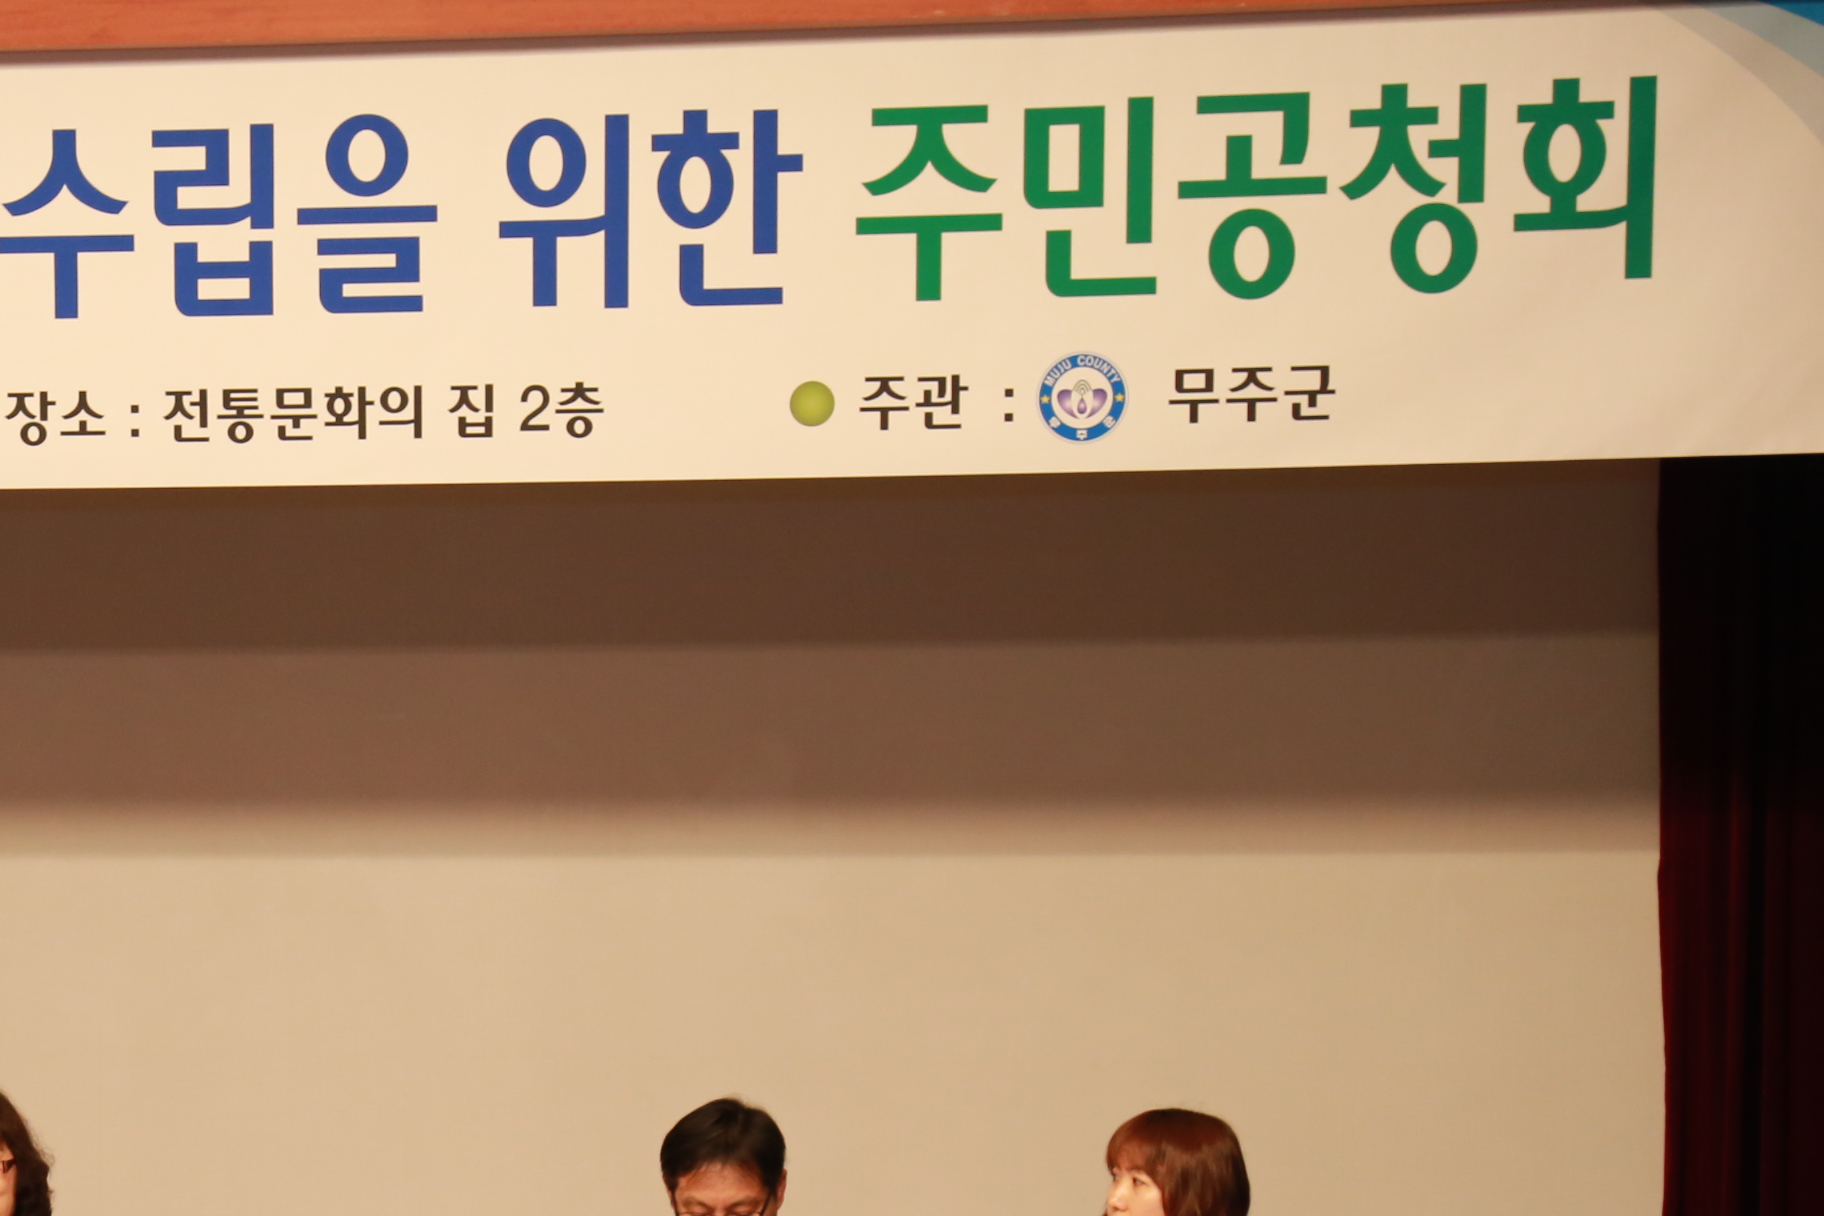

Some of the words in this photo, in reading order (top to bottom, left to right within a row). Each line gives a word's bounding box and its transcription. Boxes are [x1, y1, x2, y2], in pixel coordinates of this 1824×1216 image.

[498, 108, 804, 309] 위한
[855, 74, 1659, 302] 주민공청회
[859, 374, 969, 431] 주관
[1168, 365, 1337, 424] 무주군
[1044, 357, 1072, 387] MUJU
[1077, 355, 1121, 384] COUNTY
[5, 390, 107, 447] 장소
[163, 384, 423, 444] 전통문화의
[448, 383, 494, 439] 집
[519, 381, 605, 439] 2층
